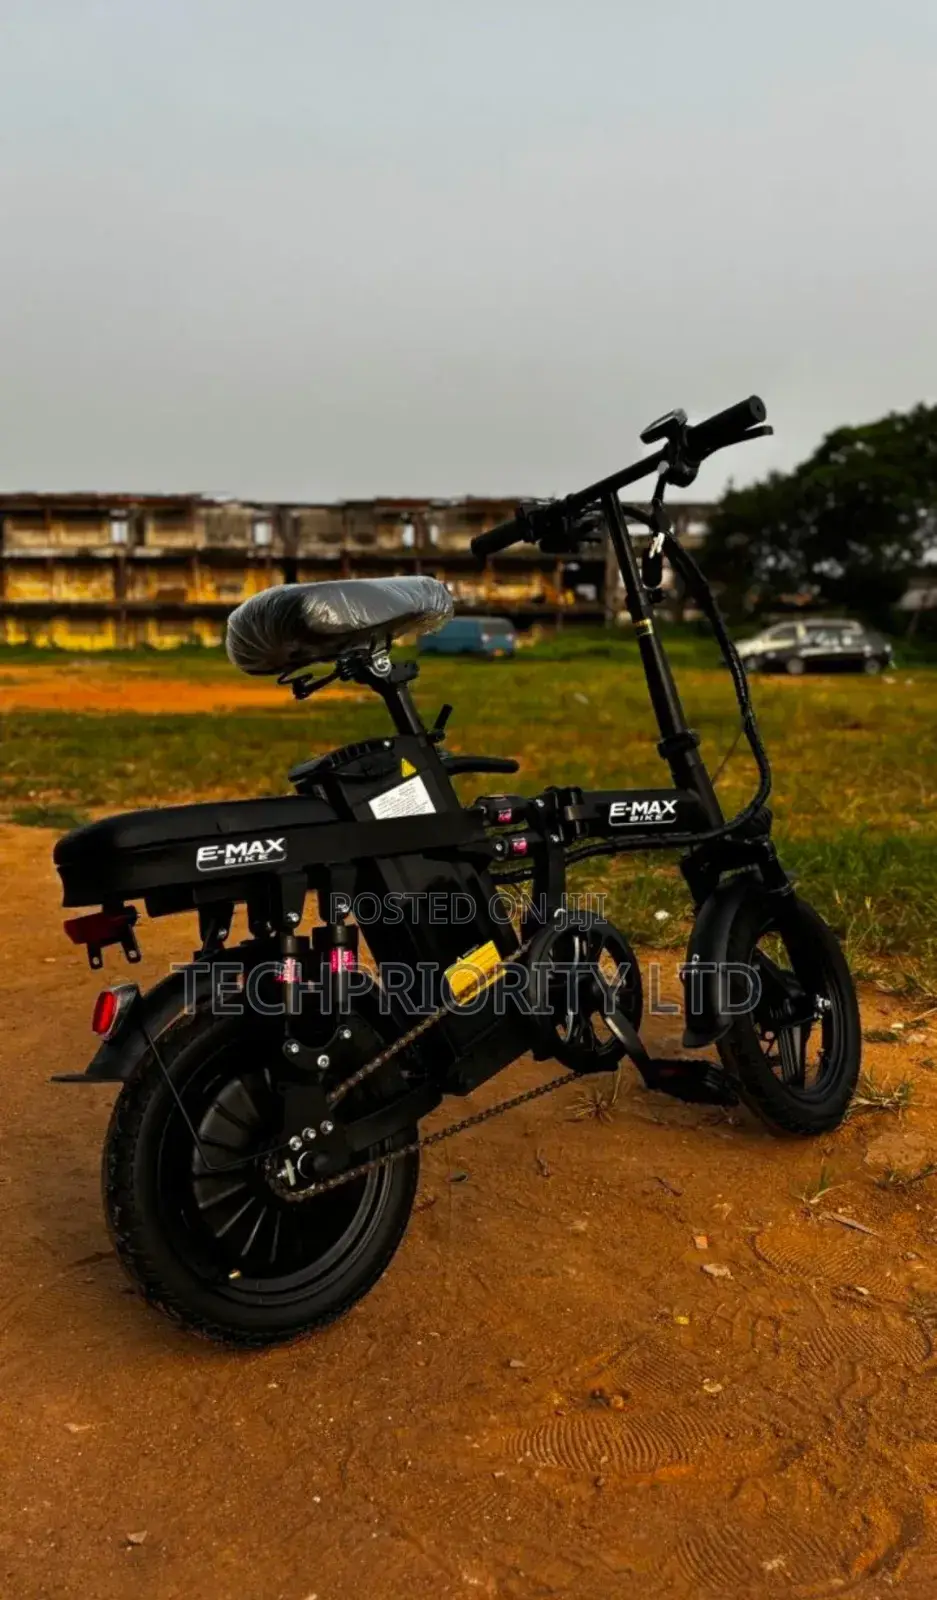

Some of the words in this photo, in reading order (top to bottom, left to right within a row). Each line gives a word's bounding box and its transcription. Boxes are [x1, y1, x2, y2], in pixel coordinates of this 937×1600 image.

[610, 800, 678, 817] E-MAX
[197, 837, 286, 862] E-MAX
[224, 852, 269, 866] BIKE
